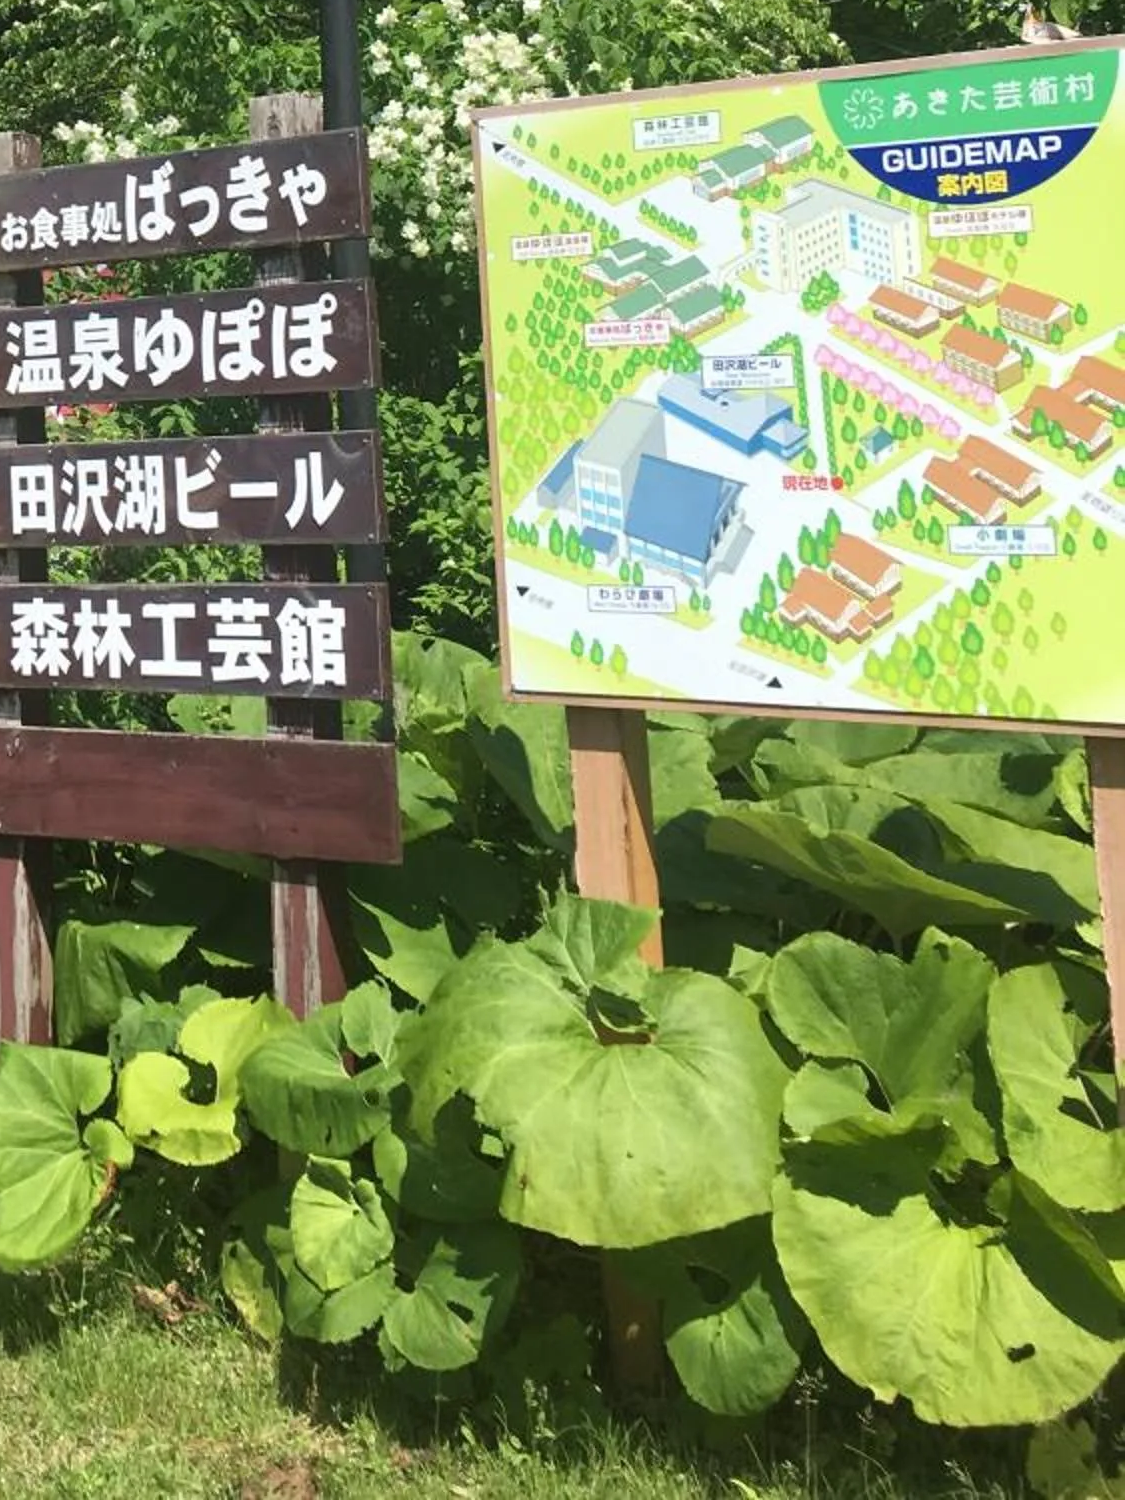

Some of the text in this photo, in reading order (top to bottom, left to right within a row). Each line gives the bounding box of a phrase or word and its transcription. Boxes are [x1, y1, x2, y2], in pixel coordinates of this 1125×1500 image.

[892, 72, 1094, 119] あきた芸術村
[882, 135, 1062, 173] GUIDEMAP
[936, 170, 1008, 197] 案内図
[5, 292, 338, 395] 温泉ゆぽぽ
[10, 451, 344, 536] 田沢湖ビール
[11, 597, 347, 686] 森林工芸館
